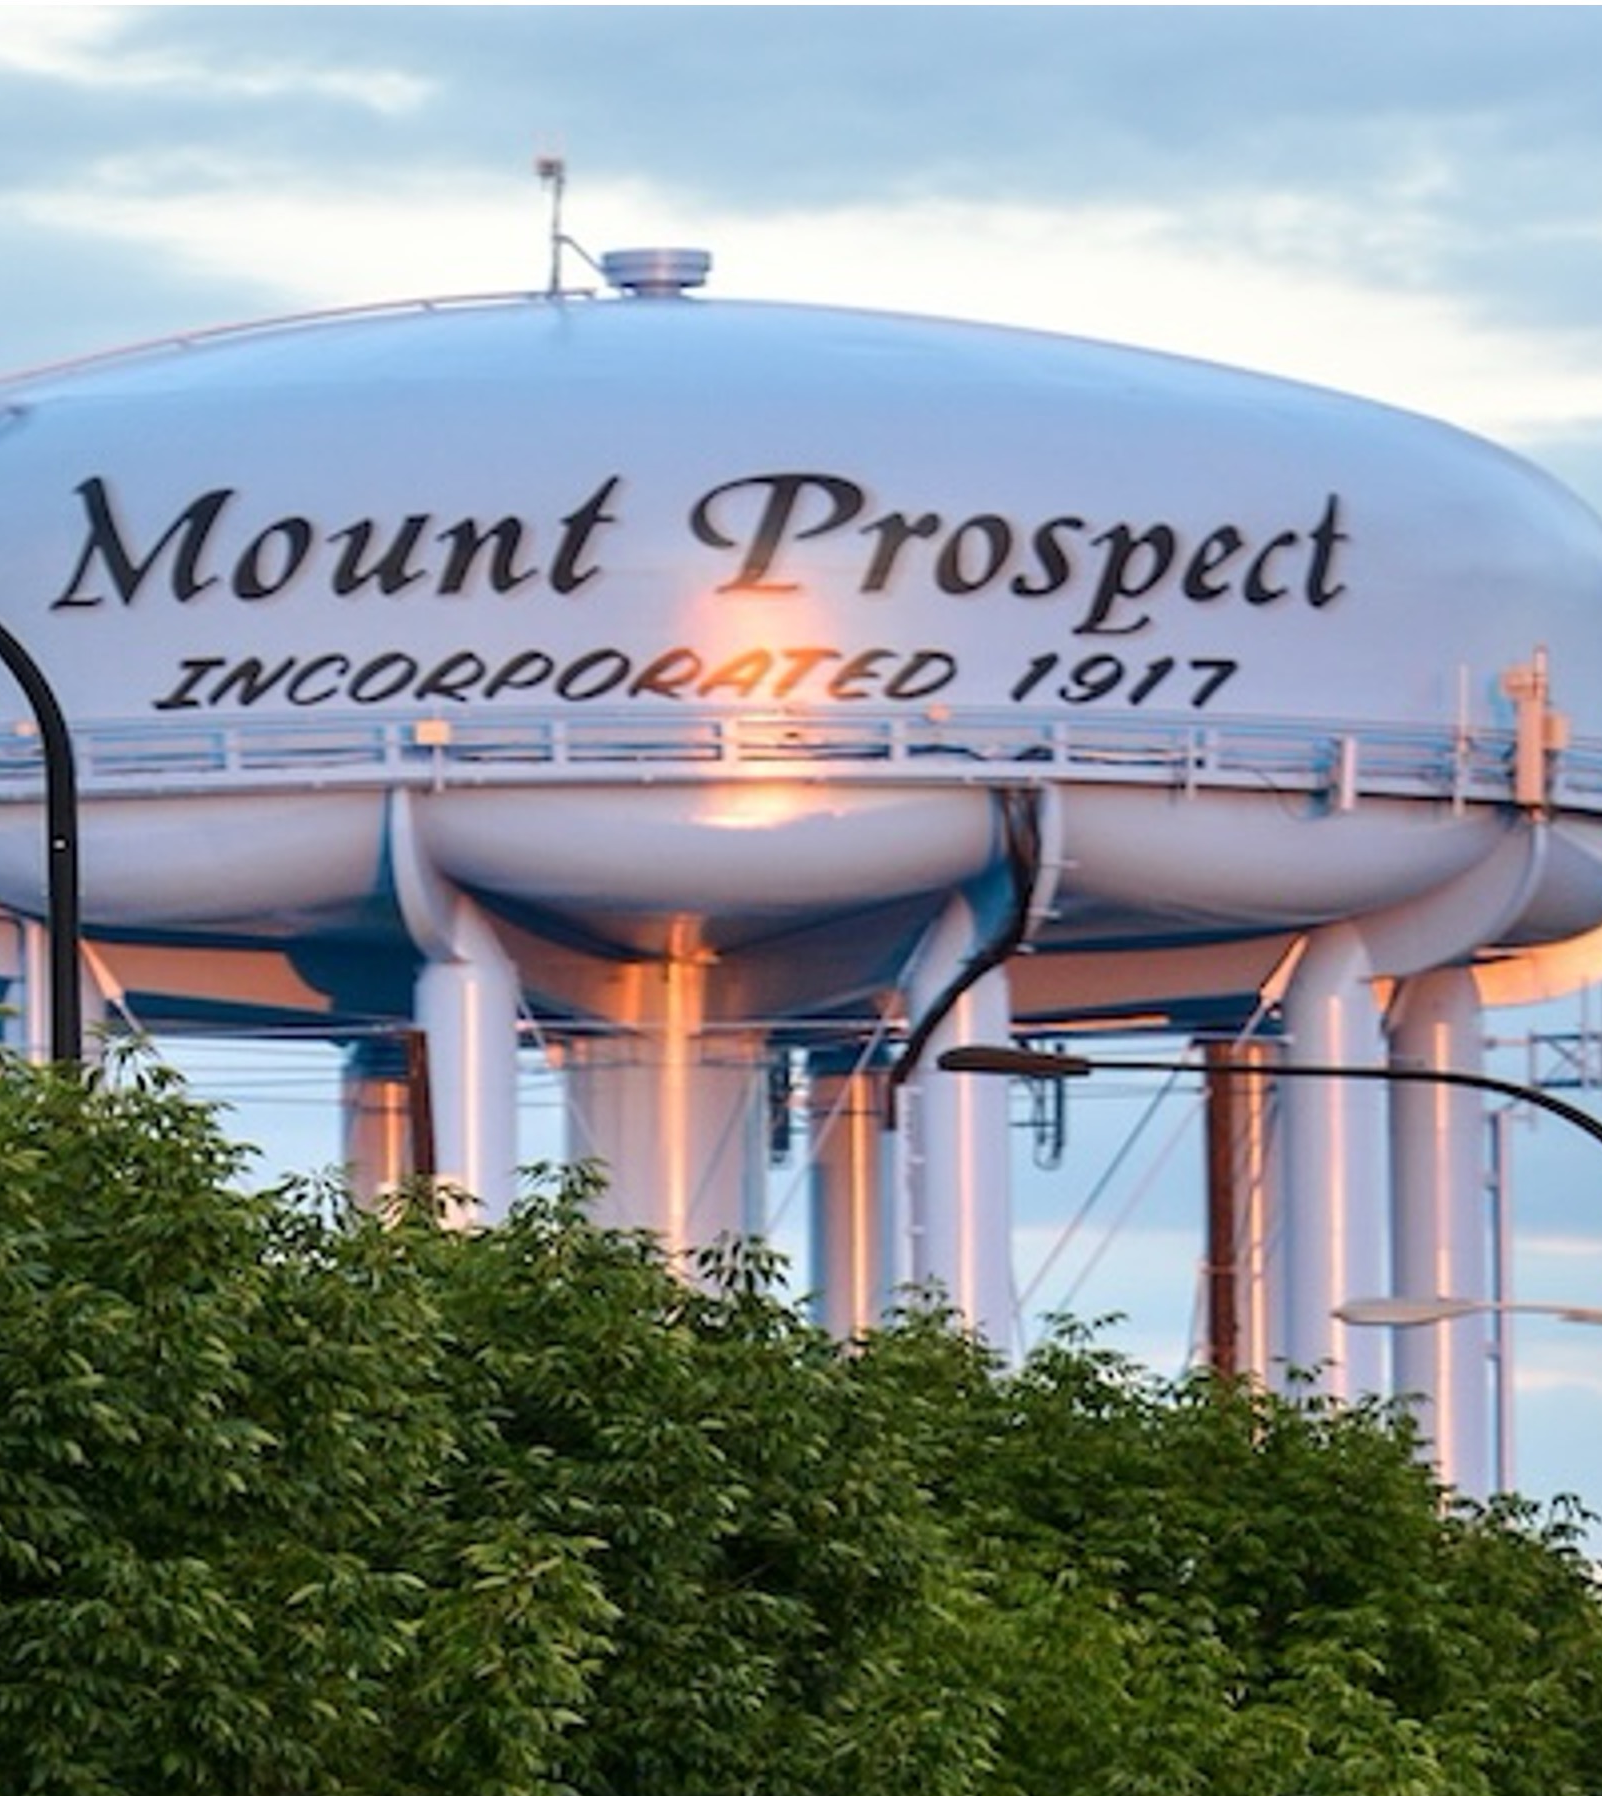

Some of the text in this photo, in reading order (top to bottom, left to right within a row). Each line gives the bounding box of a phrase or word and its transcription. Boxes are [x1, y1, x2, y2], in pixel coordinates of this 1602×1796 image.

[49, 473, 1349, 635] Mount Prospect
[153, 647, 1239, 710] INCORPORATED 1917
